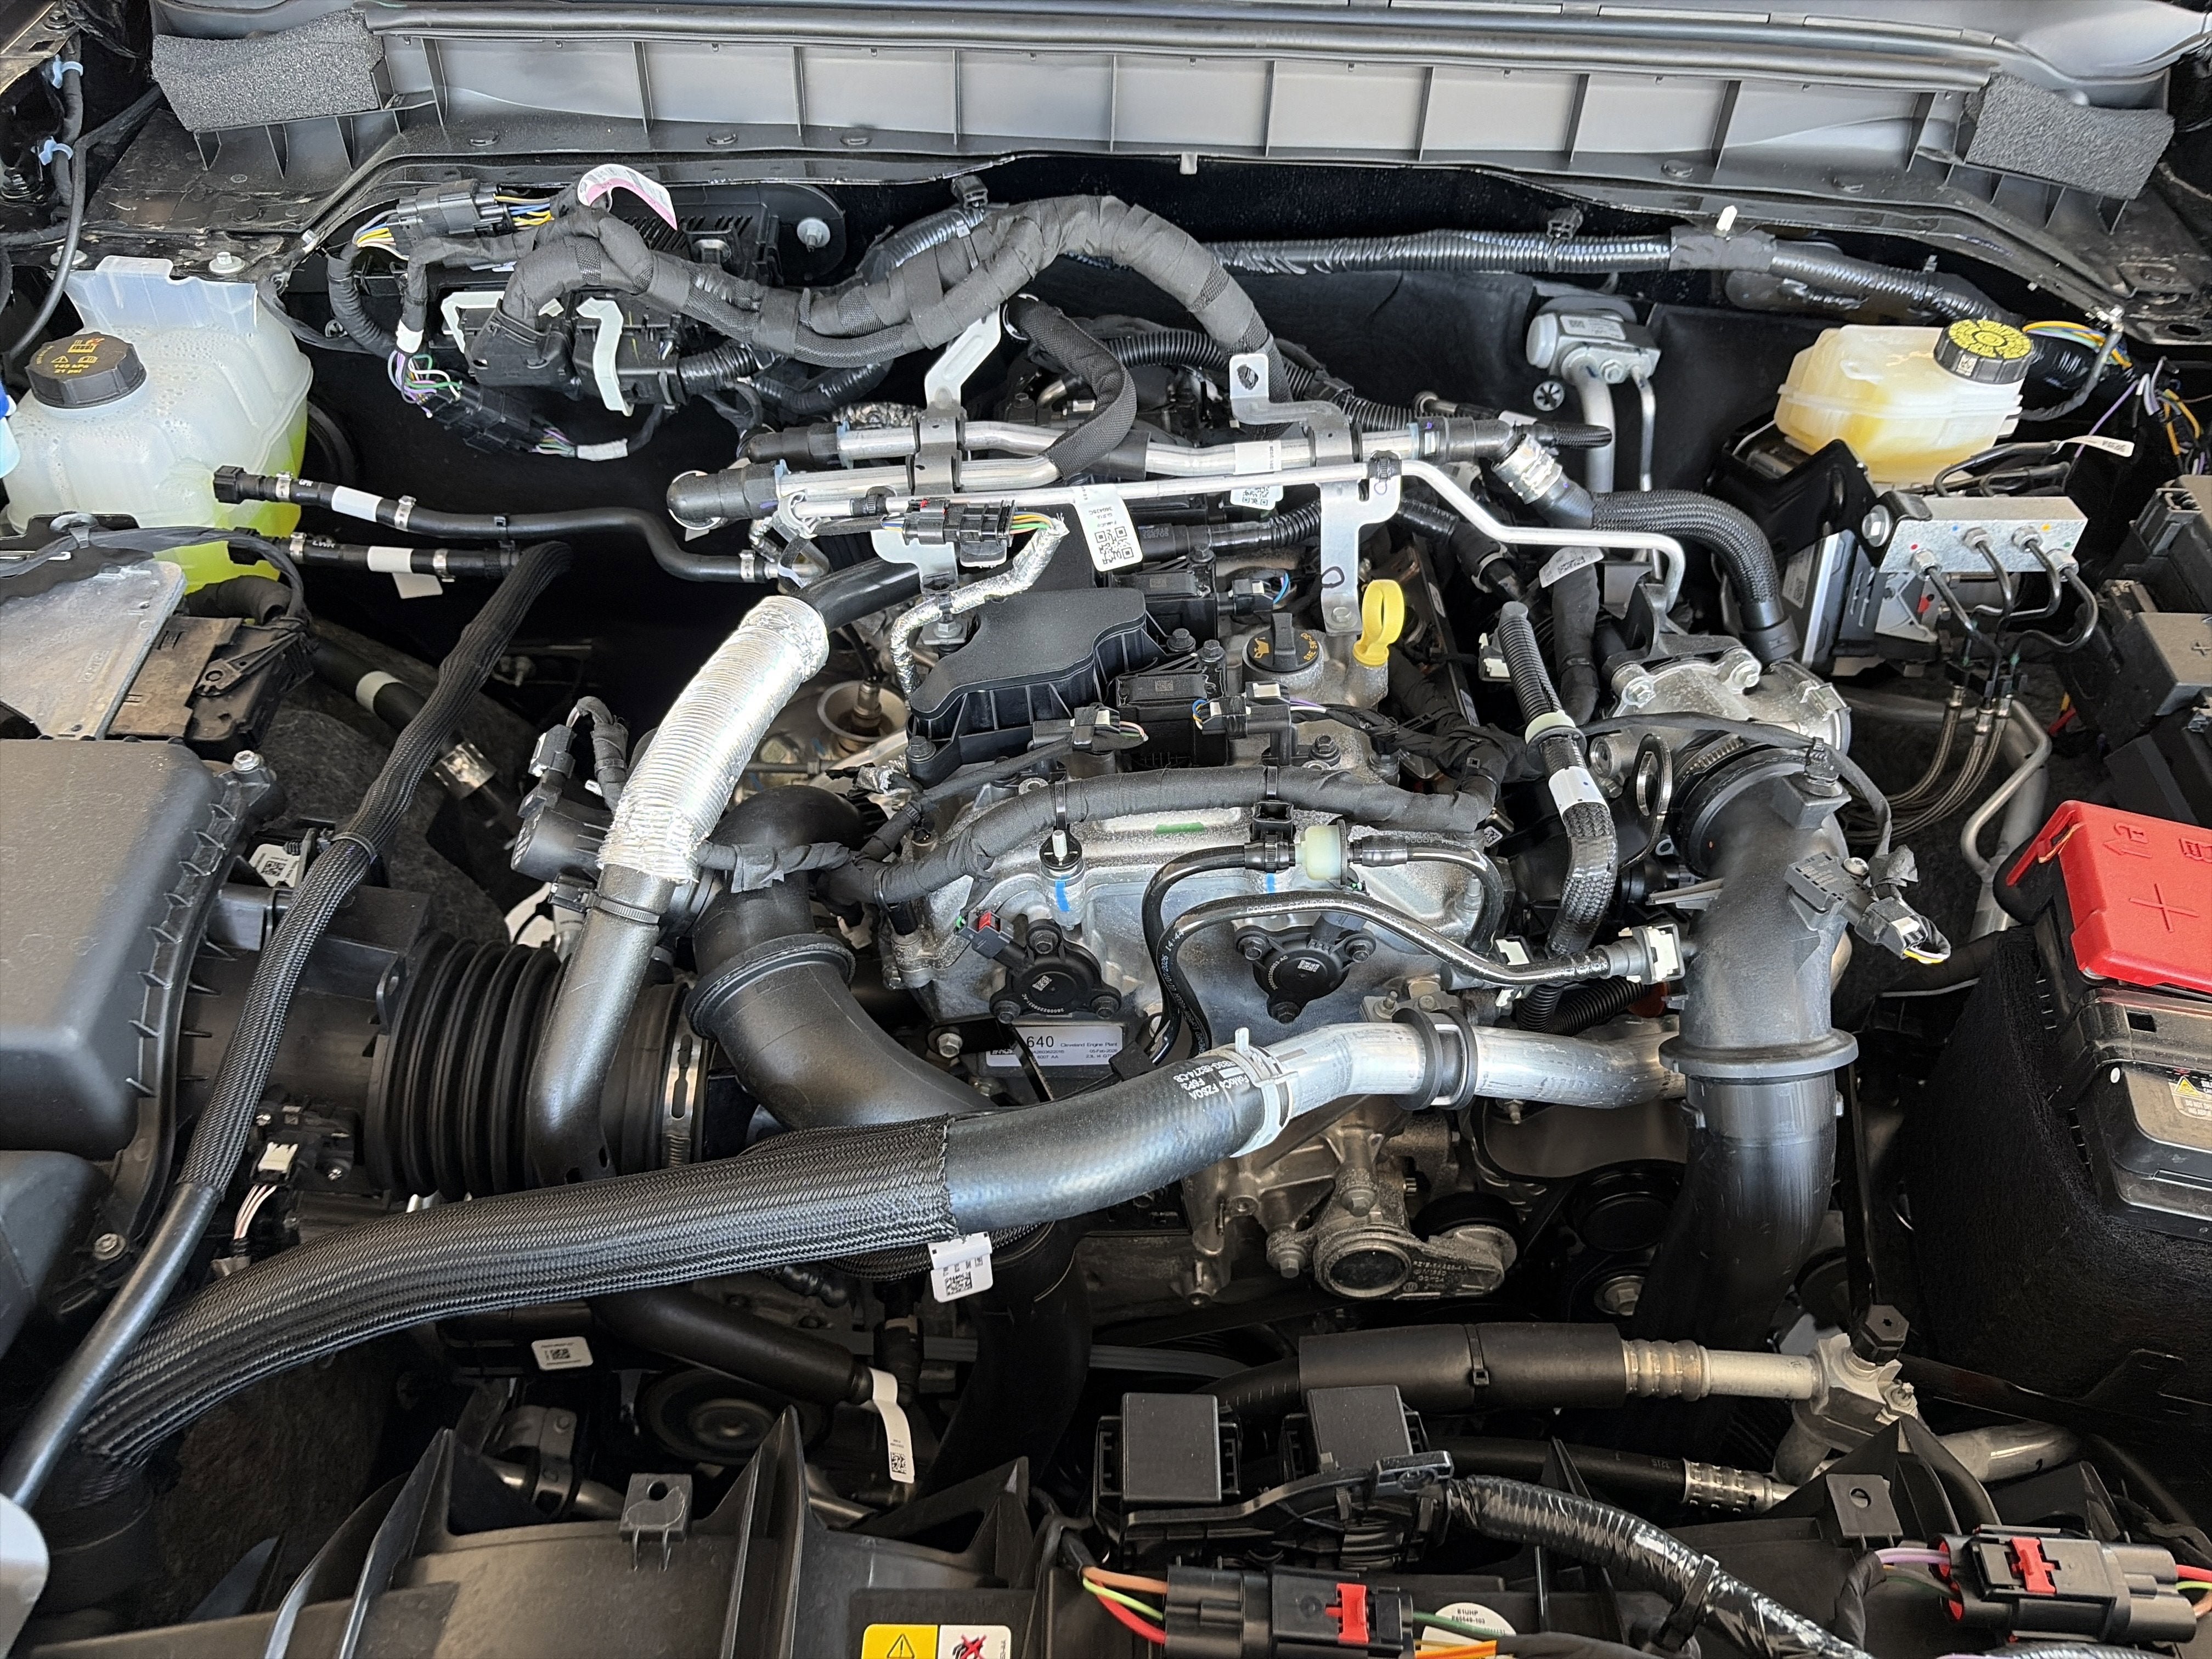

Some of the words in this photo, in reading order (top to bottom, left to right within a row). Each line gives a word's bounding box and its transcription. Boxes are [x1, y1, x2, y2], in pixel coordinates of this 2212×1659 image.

[1303, 650, 1317, 661] SAE
[1246, 904, 1282, 914] COOPER
[1165, 929, 1184, 952] 14:44
[1026, 1035, 1054, 1048] 640
[1219, 1075, 1250, 1089] FoMoCo
